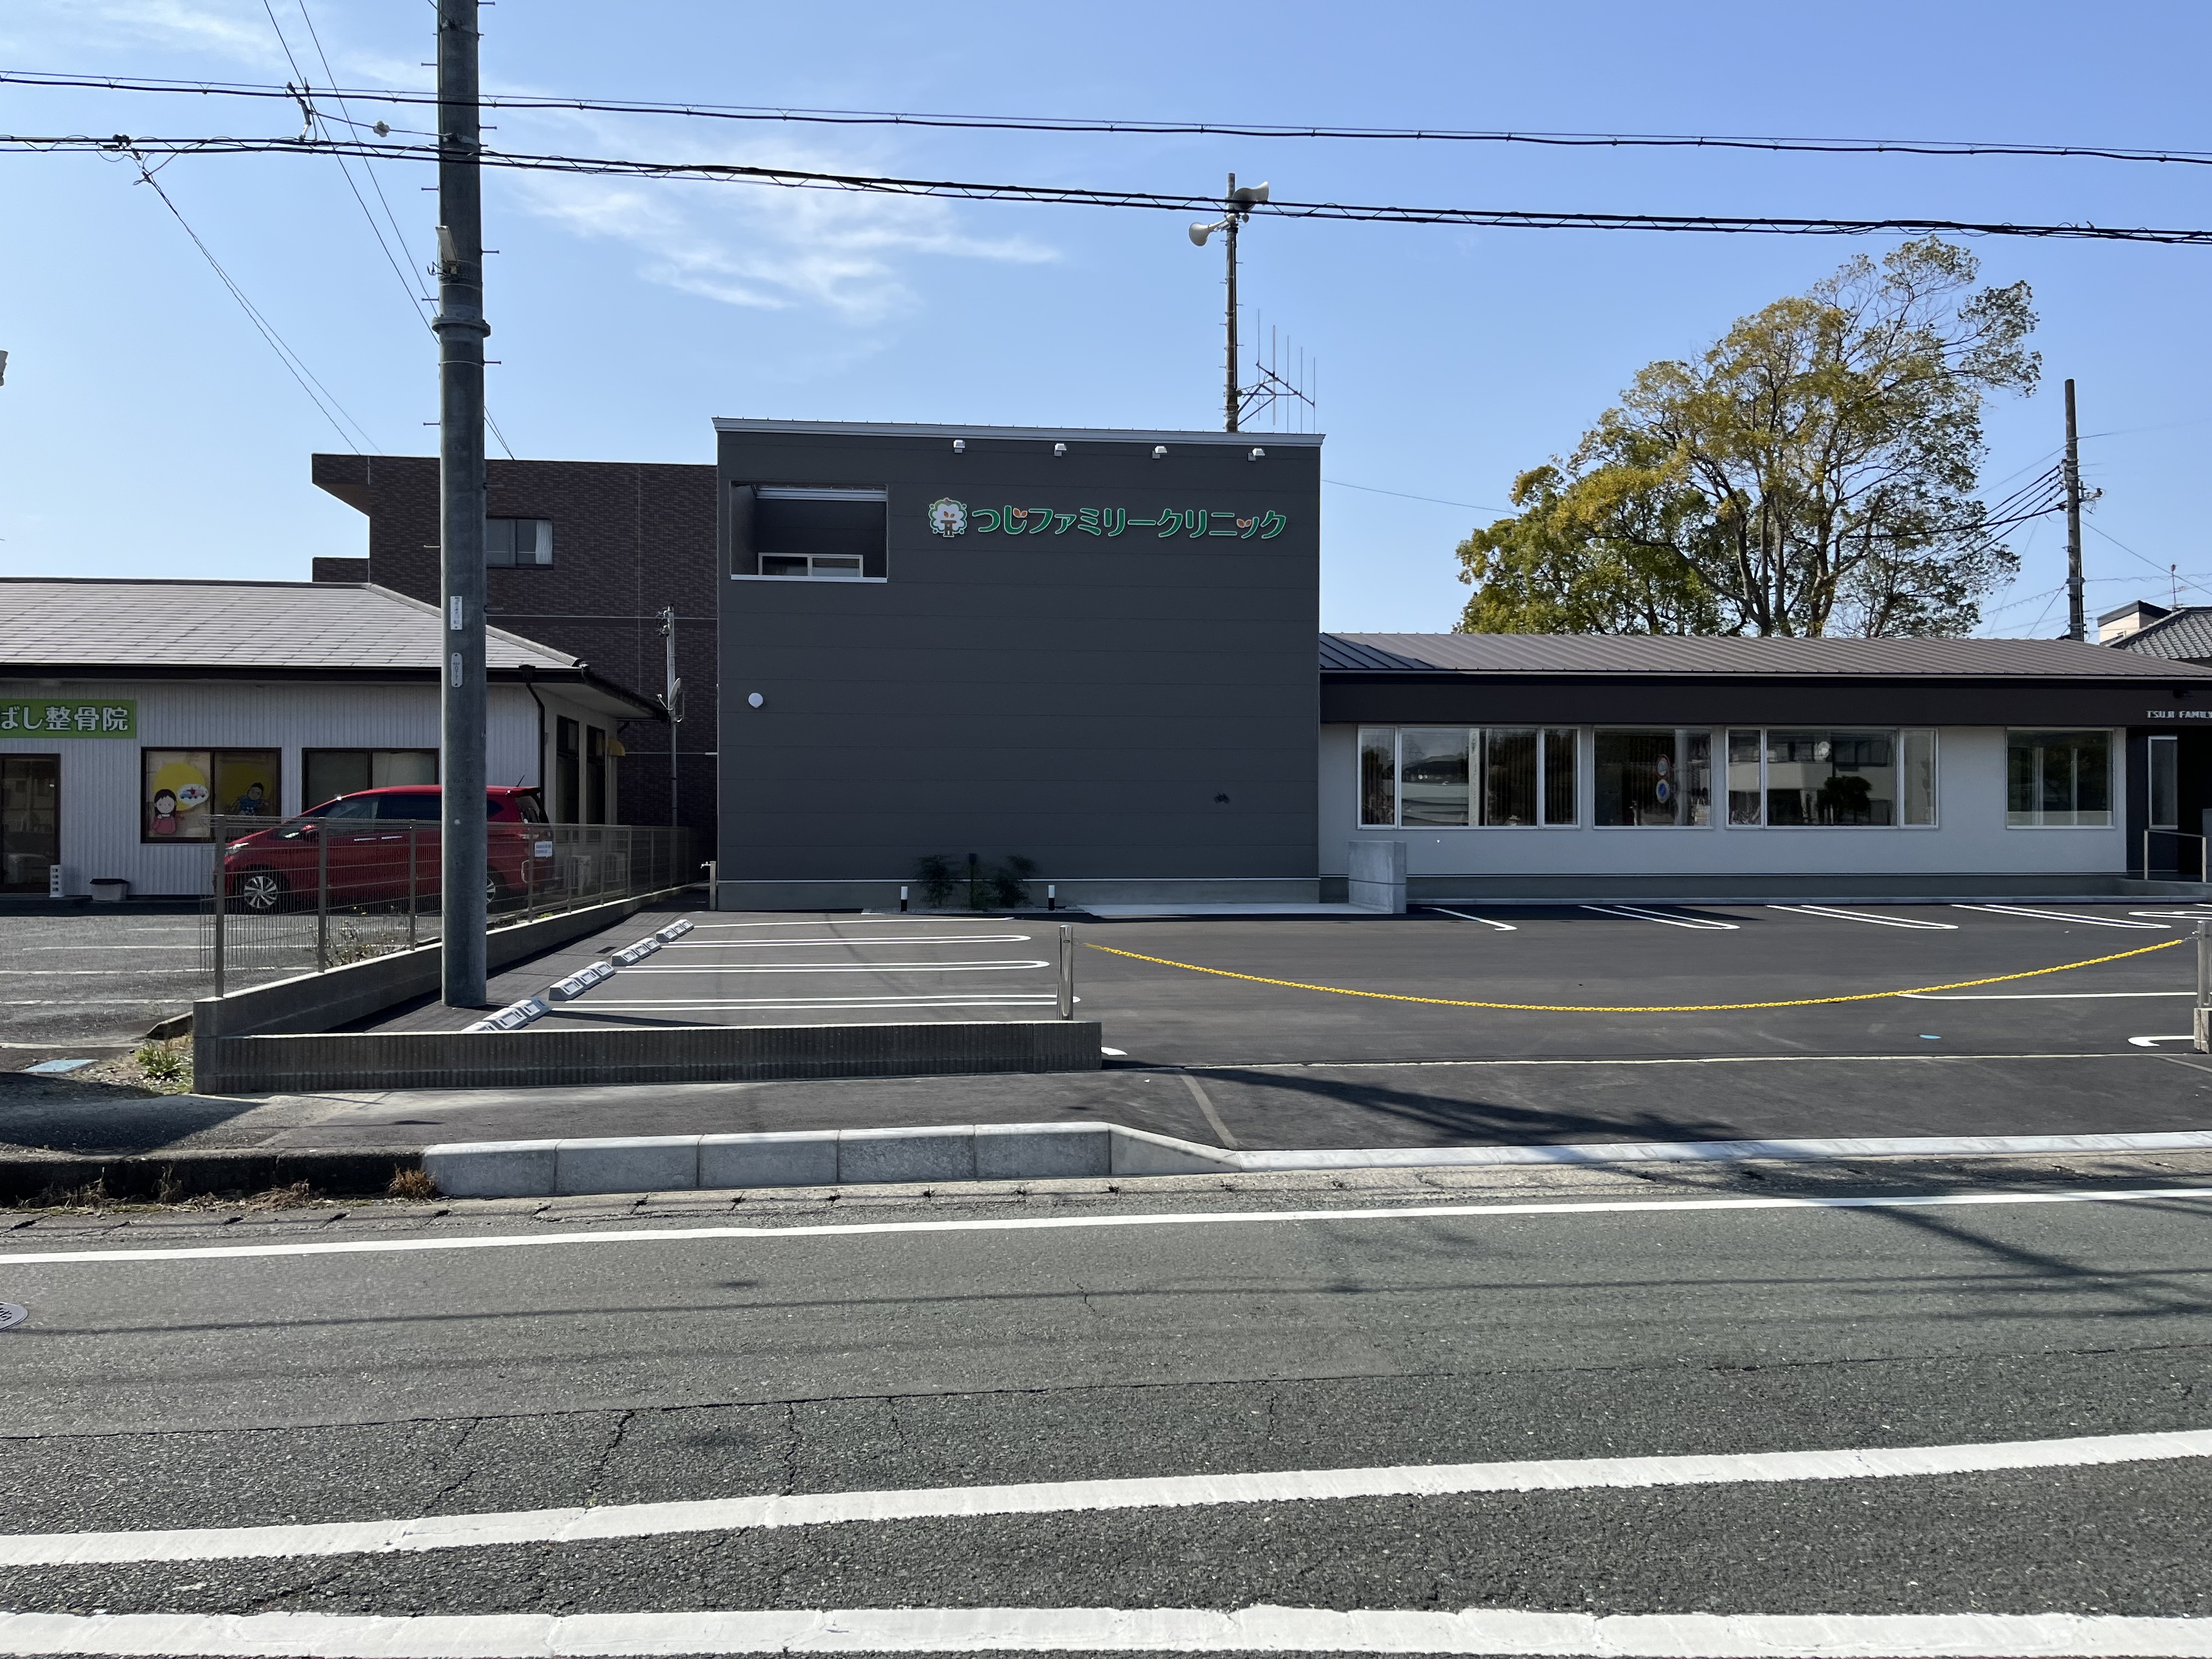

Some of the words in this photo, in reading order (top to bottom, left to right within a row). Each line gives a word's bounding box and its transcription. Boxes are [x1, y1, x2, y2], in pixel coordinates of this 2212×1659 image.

[971, 504, 1287, 539] つじファミリークリニック
[0, 706, 128, 731] ばし整骨院
